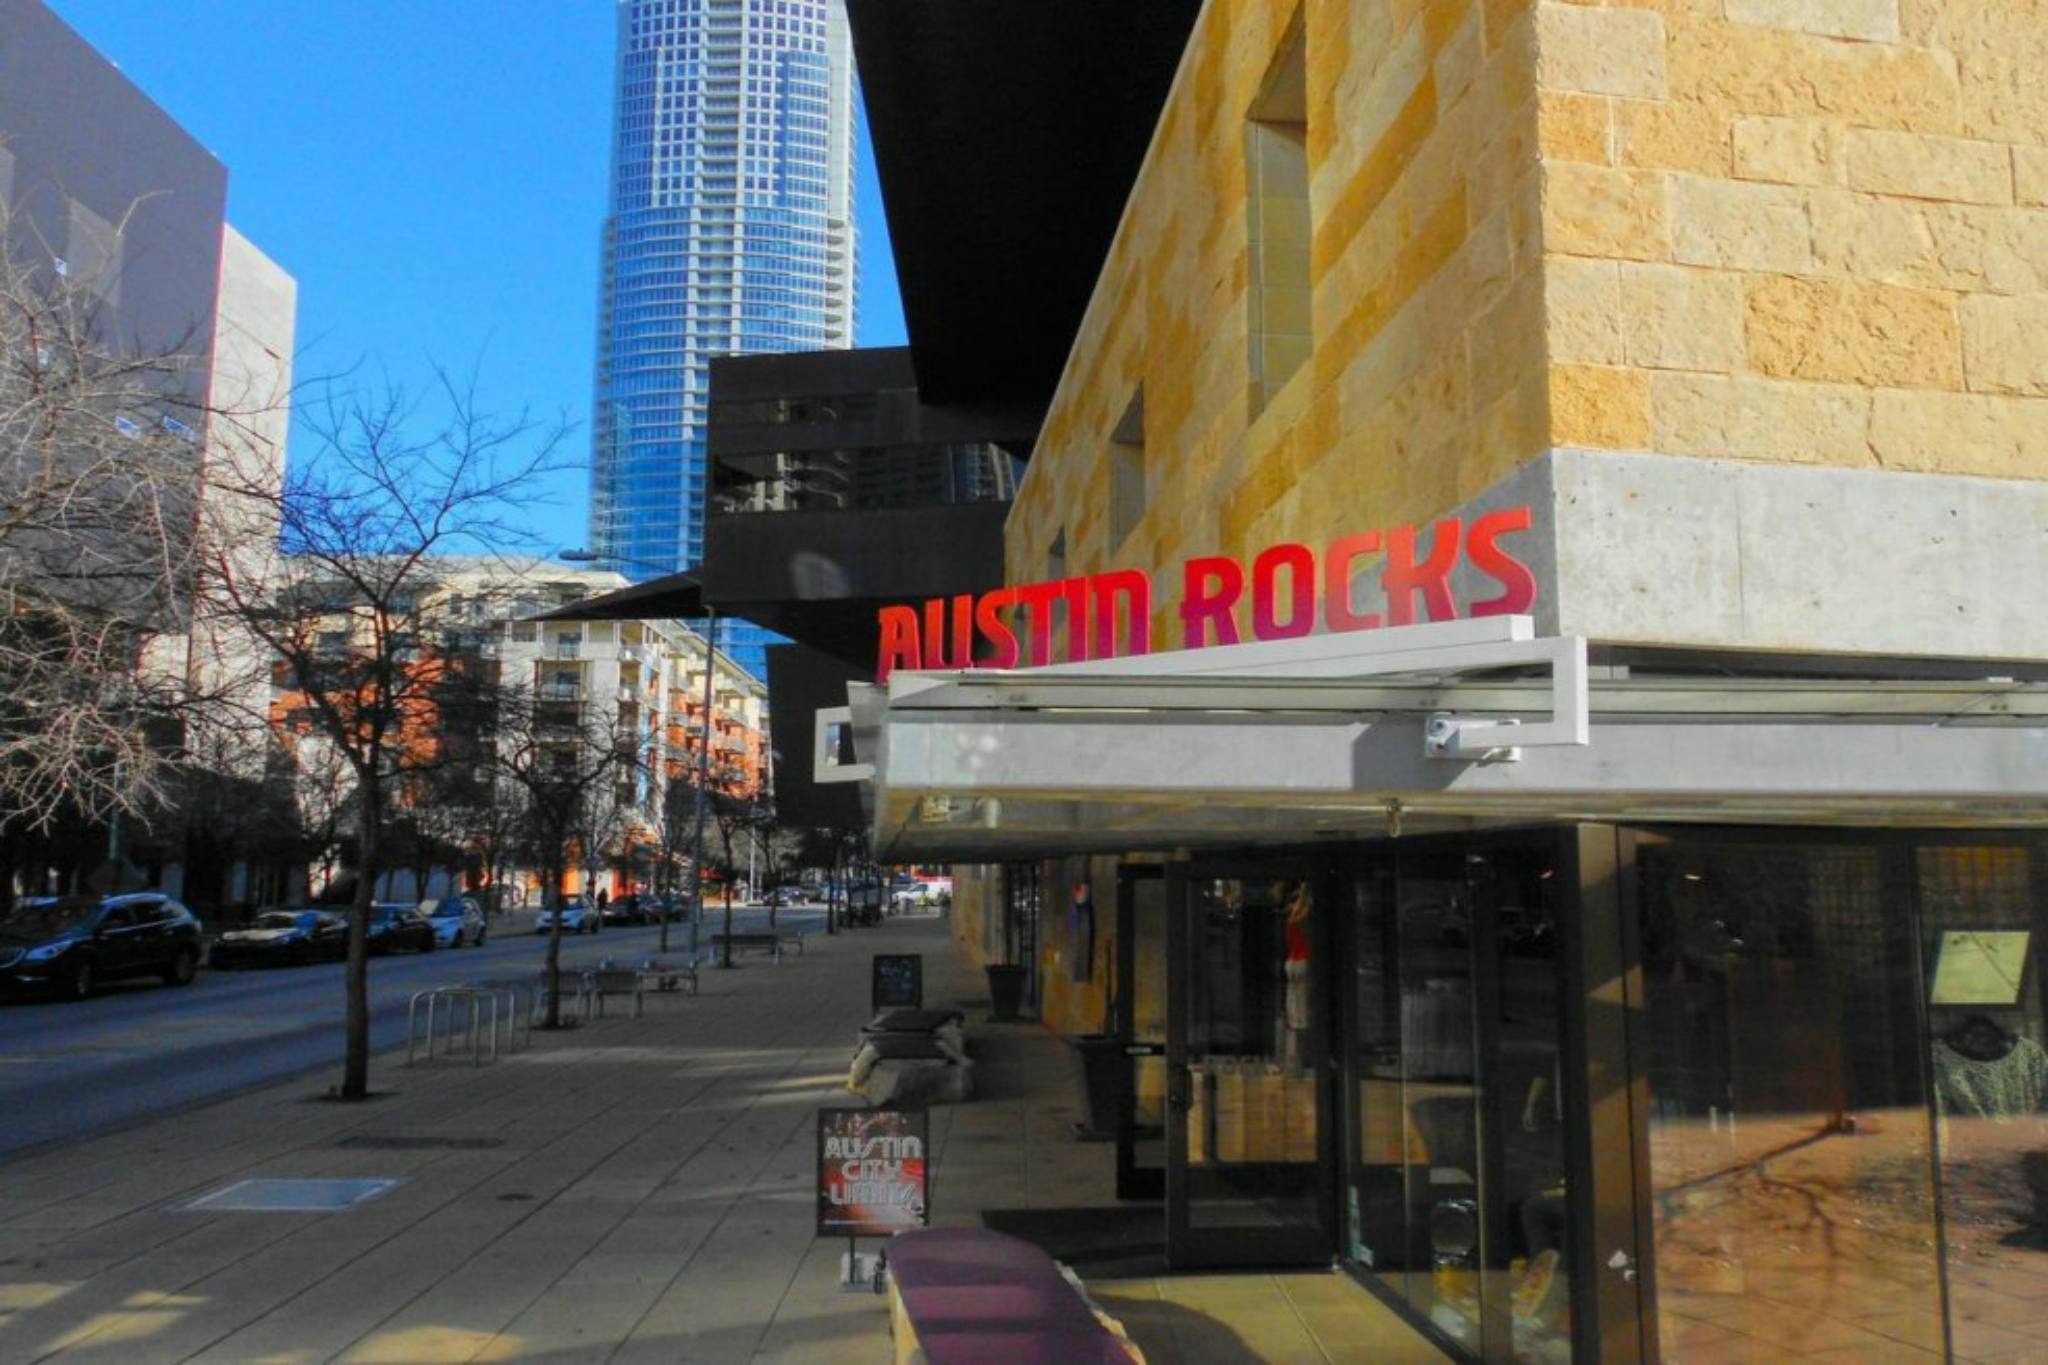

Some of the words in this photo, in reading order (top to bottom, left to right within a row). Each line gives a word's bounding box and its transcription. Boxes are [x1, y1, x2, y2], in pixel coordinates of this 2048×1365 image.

[876, 567, 1150, 686] AUSTIN
[1178, 505, 1538, 649] ROCKS
[823, 1136, 923, 1158] AUSTIN
[841, 1159, 903, 1182] CITY
